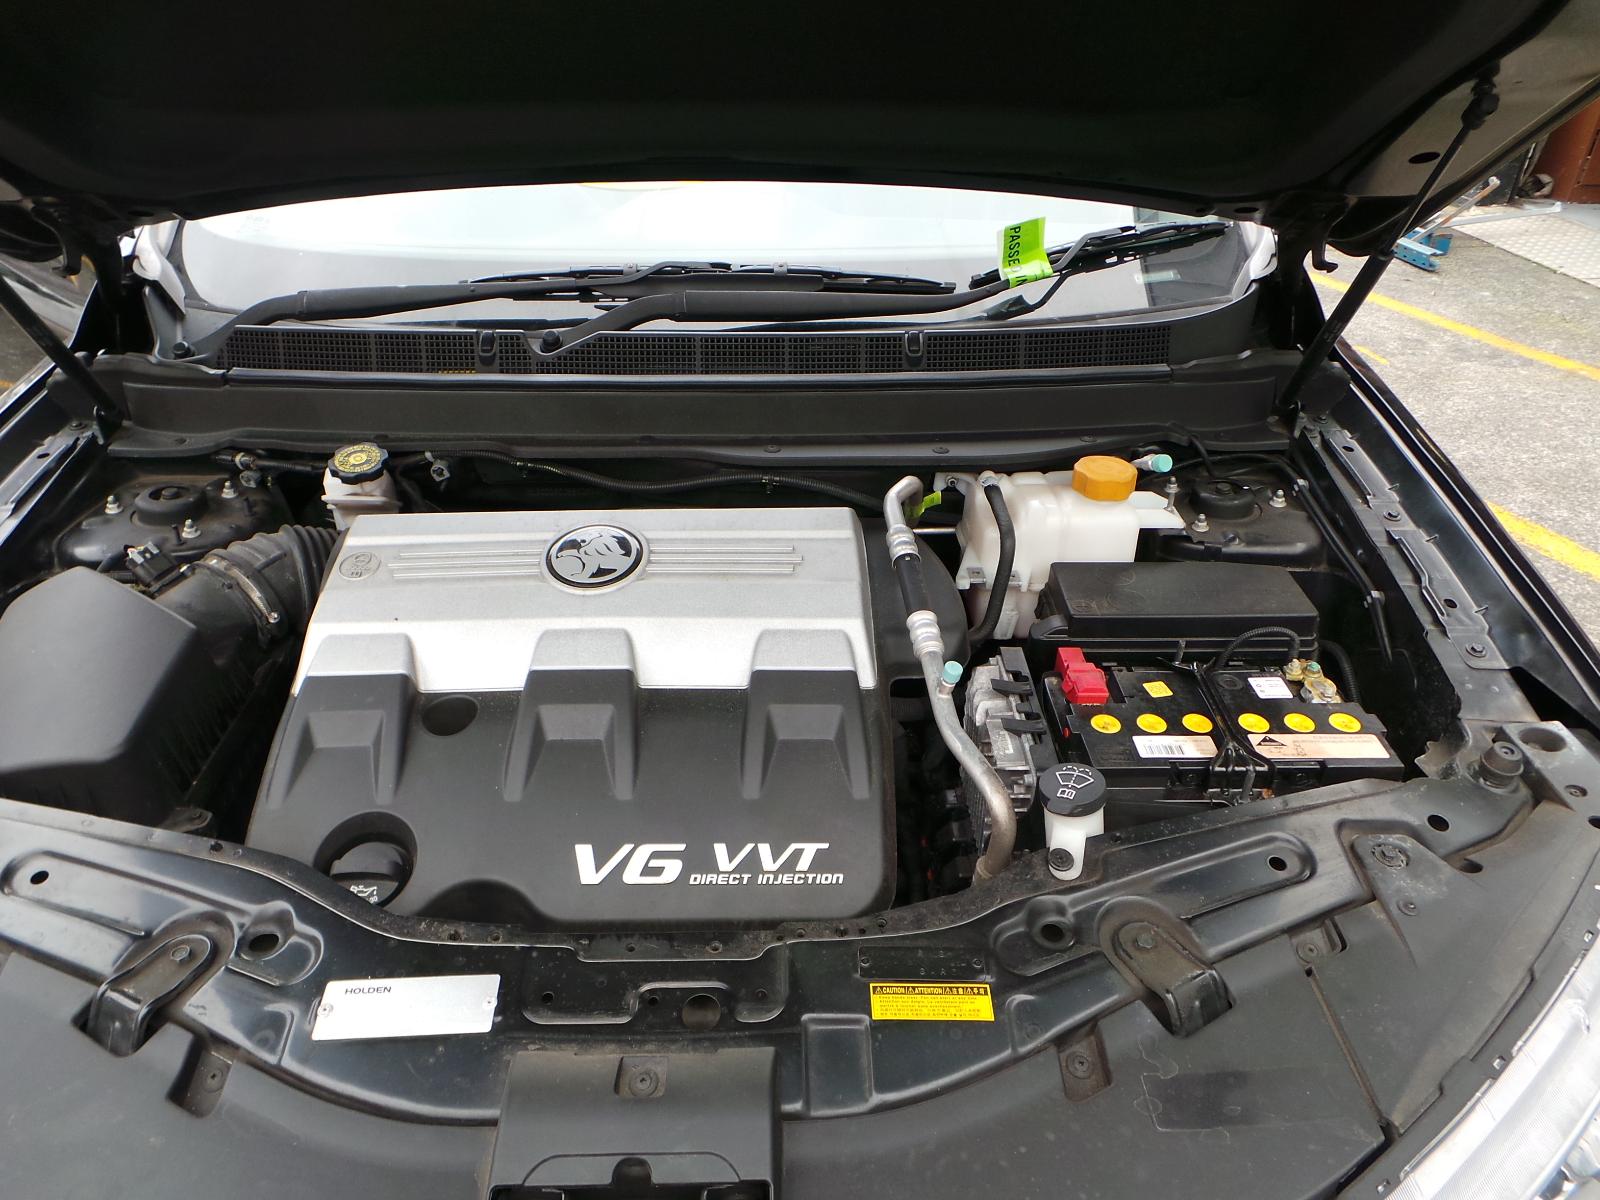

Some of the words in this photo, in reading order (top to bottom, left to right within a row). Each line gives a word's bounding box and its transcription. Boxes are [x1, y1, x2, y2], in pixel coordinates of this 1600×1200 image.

[574, 843, 687, 885] V6
[713, 842, 830, 872] VVT
[689, 873, 752, 885] DIRECT
[757, 873, 844, 885] INJECTION
[345, 986, 392, 995] HOLDEN
[882, 986, 905, 994] CAUTION
[914, 987, 943, 995] ATTENTION
